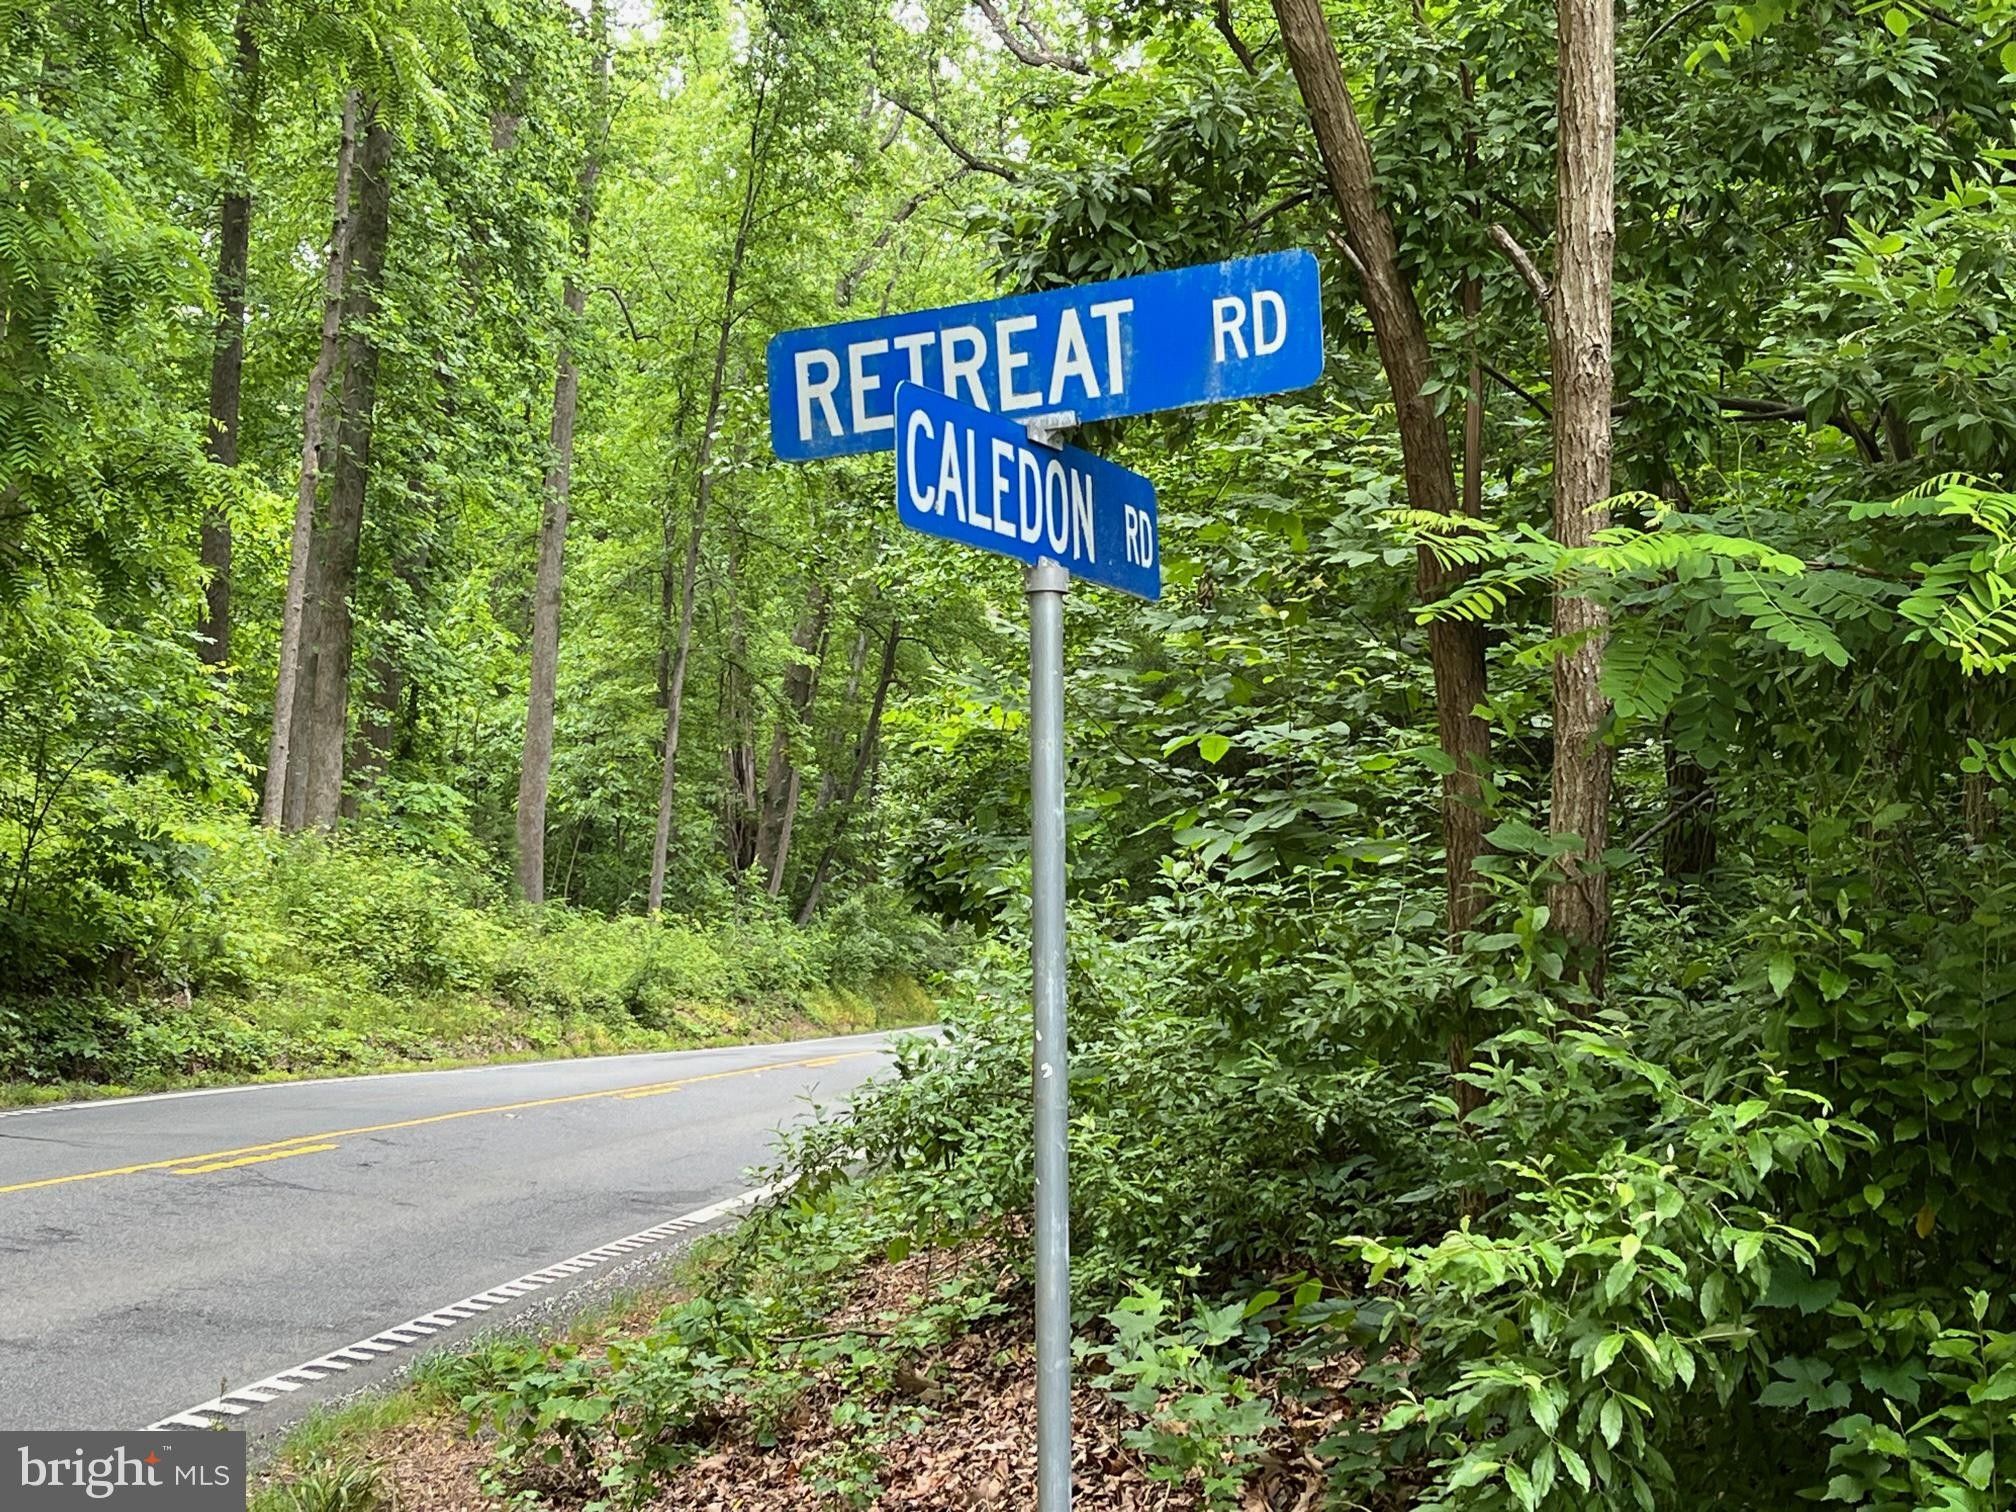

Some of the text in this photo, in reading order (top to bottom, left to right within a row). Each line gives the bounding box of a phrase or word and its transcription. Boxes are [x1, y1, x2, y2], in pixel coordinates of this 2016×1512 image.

[794, 290, 1287, 441] RETREAT RD
[907, 409, 1153, 568] CALEDON RD
